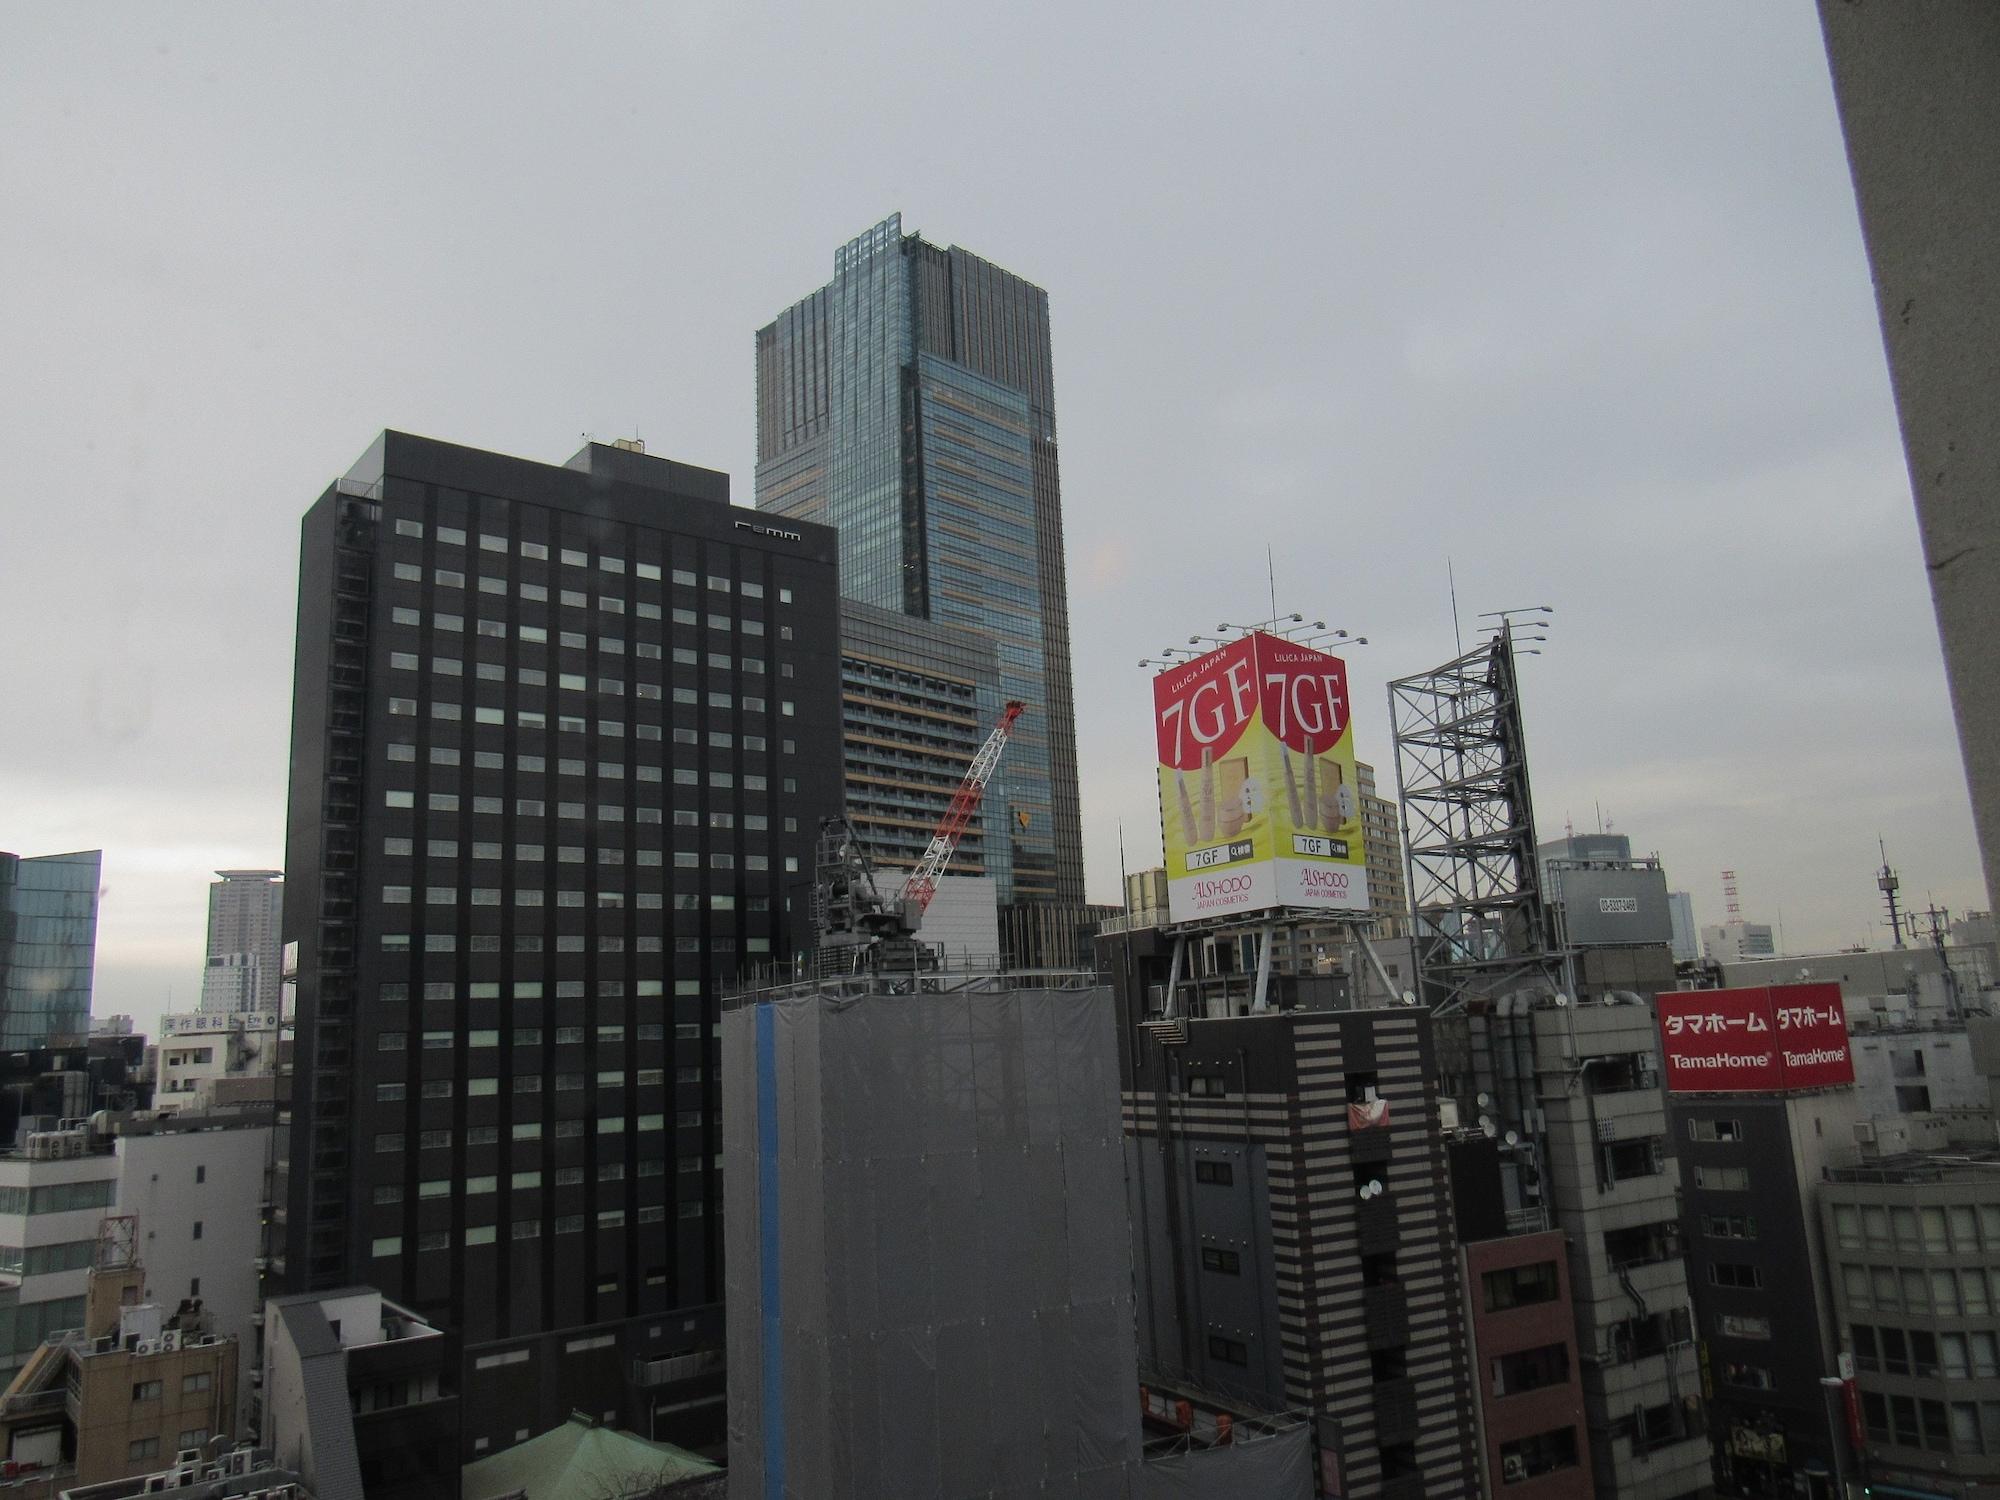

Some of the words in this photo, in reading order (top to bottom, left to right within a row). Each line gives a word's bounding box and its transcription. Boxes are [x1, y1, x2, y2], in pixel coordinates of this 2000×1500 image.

[734, 521, 801, 541] remm
[1274, 653, 1299, 663] LILICA
[1300, 653, 1323, 663] JAPAN
[1171, 671, 1198, 694] LILICA
[1199, 649, 1227, 674] JAPAN
[1161, 657, 1251, 766] 7GF
[1265, 673, 1343, 739] 7GF
[1302, 838, 1322, 854] 7GF
[1195, 849, 1218, 867] 7GF
[1197, 899, 1216, 910] JAPAN
[1216, 894, 1249, 907] COSMETICS
[1304, 889, 1321, 897] JAPAN
[1321, 889, 1348, 899] COSMETICS
[1664, 1012, 1769, 1036] タマホーム
[1775, 1005, 1842, 1030] タマホーム
